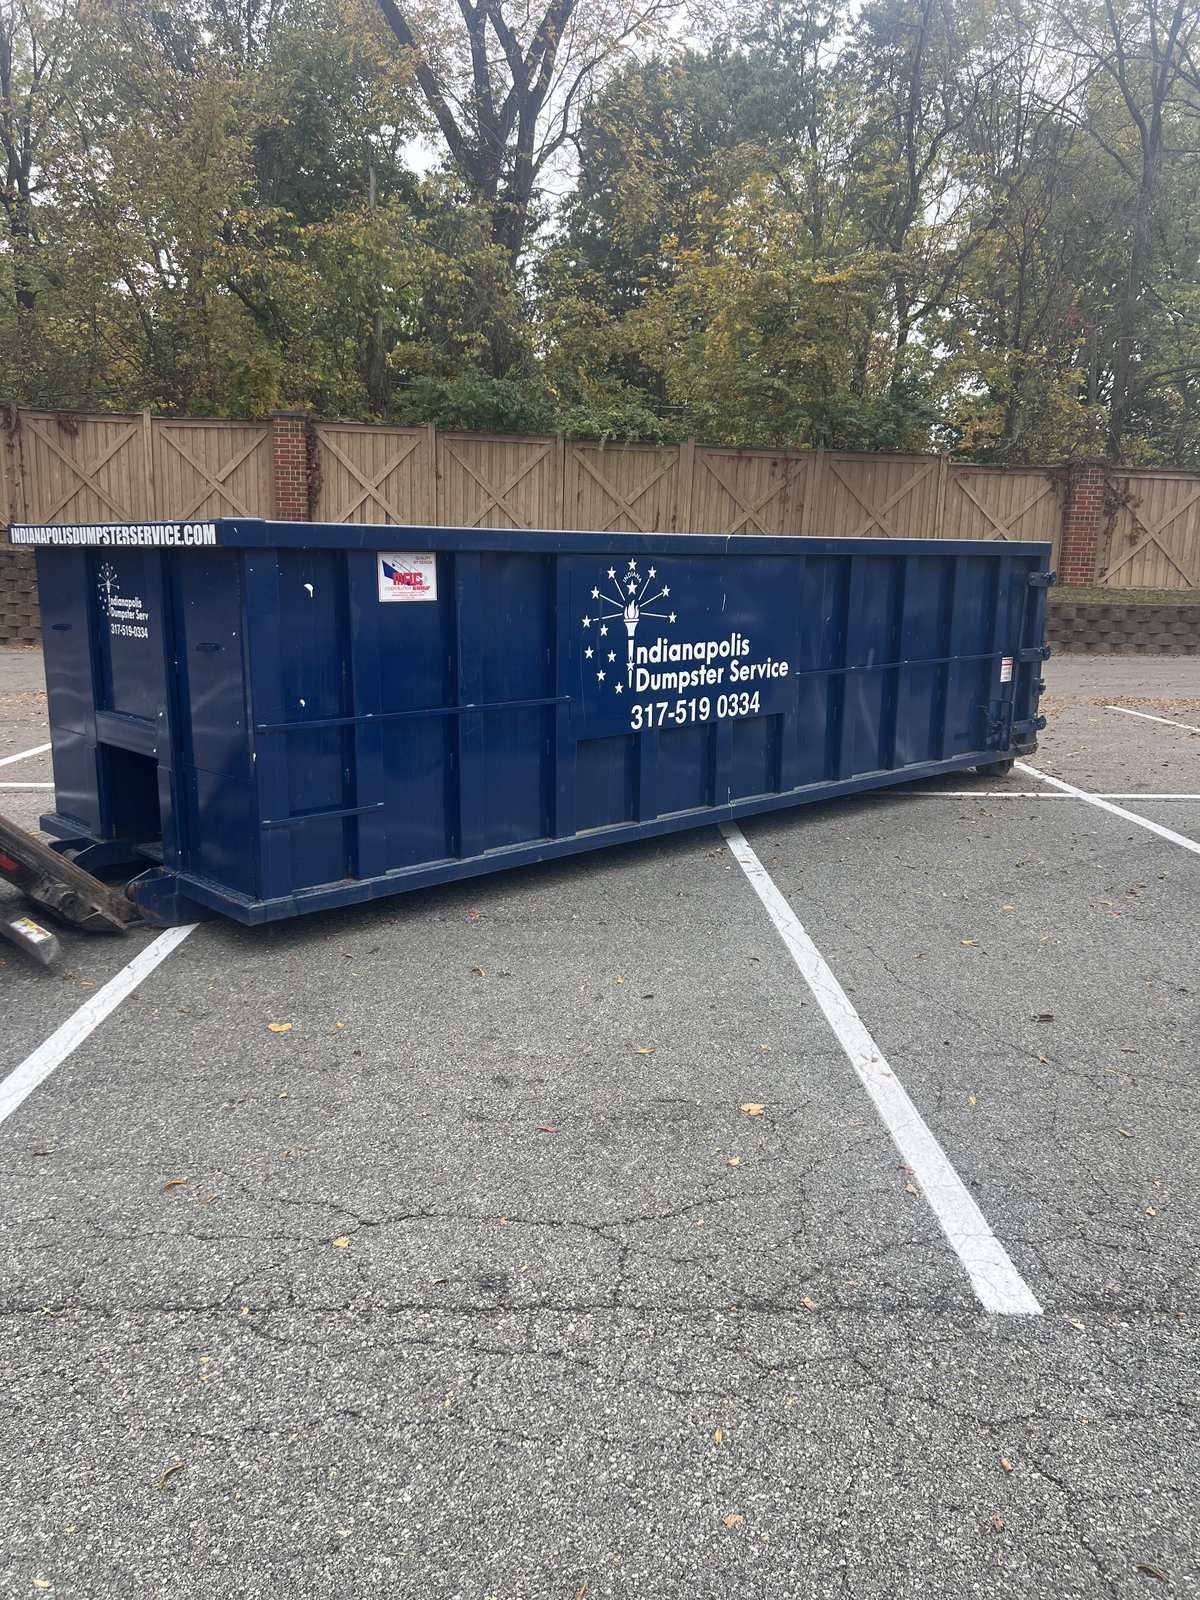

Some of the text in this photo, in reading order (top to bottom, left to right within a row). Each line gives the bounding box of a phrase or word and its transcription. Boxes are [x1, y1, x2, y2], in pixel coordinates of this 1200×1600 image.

[11, 524, 216, 545] INDIANAPOLISDUMPSTERSERVICE.COM
[623, 571, 642, 583] INDIANA
[109, 595, 142, 610] Indianapolis
[110, 607, 135, 620] Dumpster
[110, 623, 148, 638] 317-519-0334
[628, 632, 750, 664] Indianapolis
[635, 657, 789, 693] Dumpster Service
[630, 691, 760, 730] 317-519 0334
